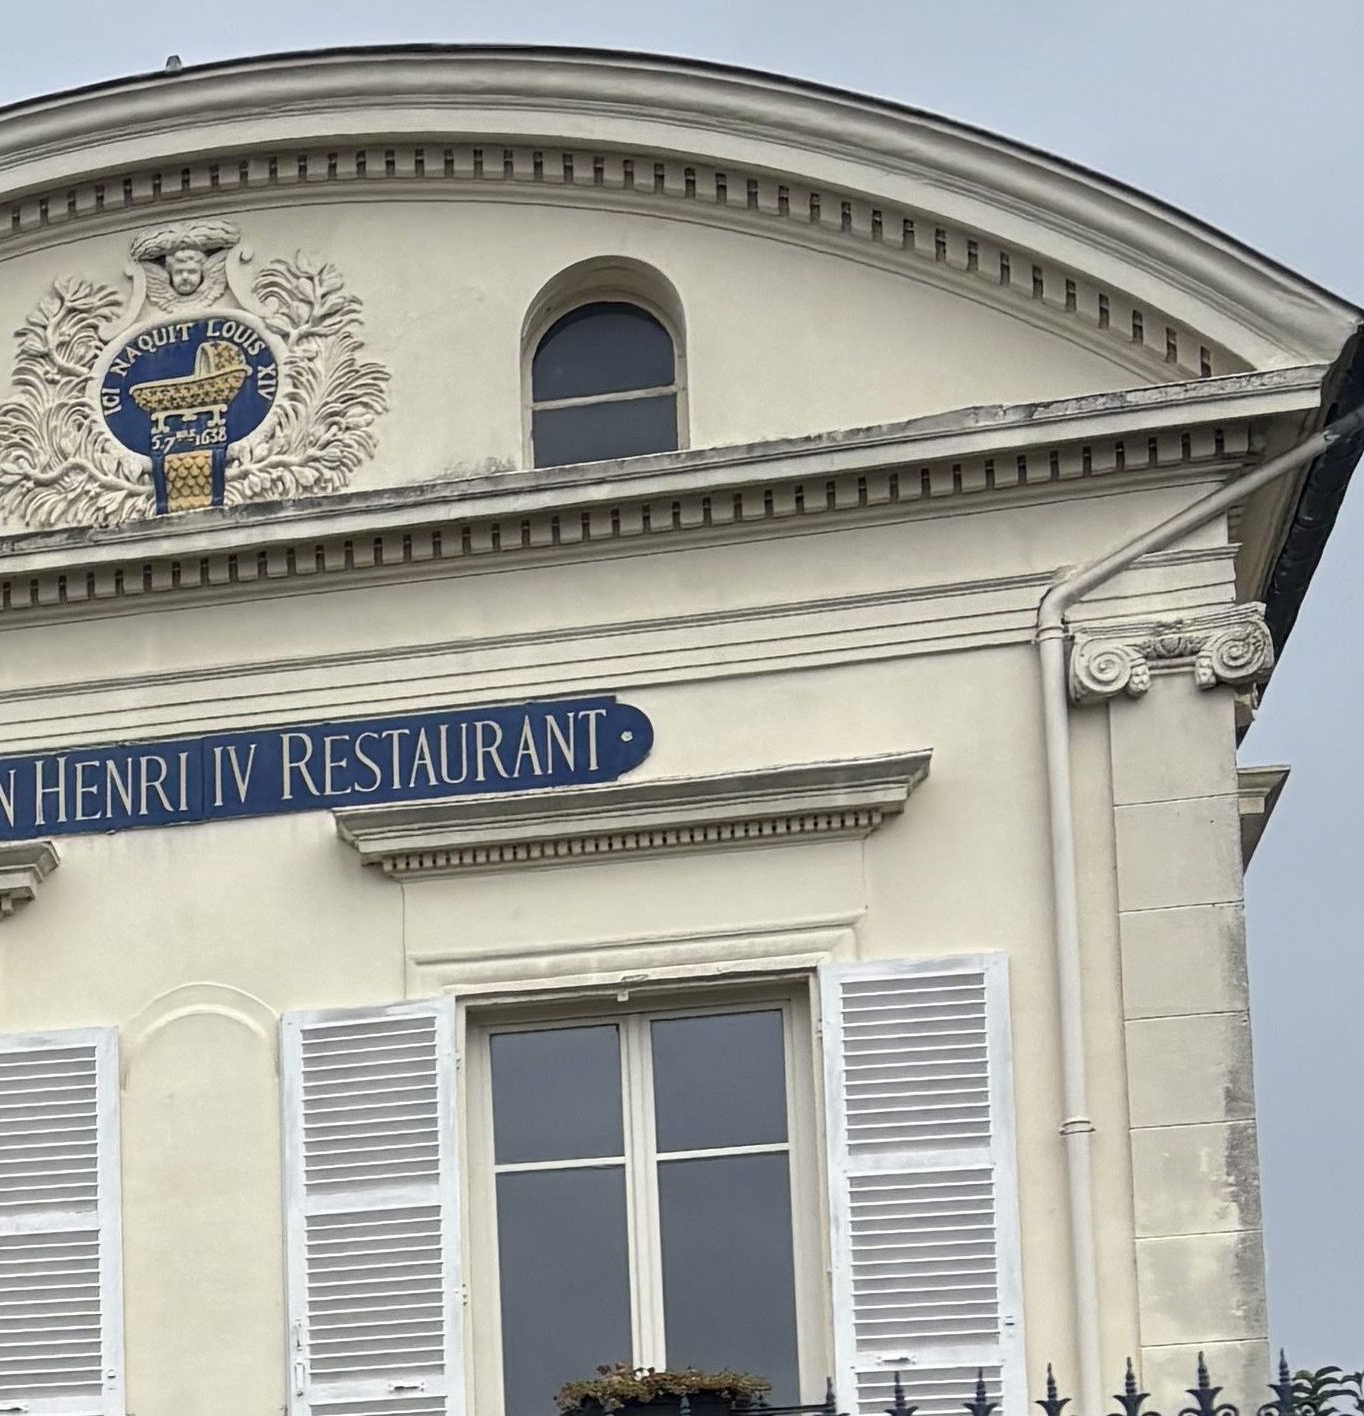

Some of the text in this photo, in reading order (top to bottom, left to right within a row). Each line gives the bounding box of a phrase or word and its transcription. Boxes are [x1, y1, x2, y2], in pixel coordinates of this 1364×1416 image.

[102, 319, 276, 416] ICI NAQUIT LOUIS XIV
[34, 751, 190, 825] HENRI
[213, 743, 257, 807] IV
[279, 708, 607, 800] RESTAURANT
